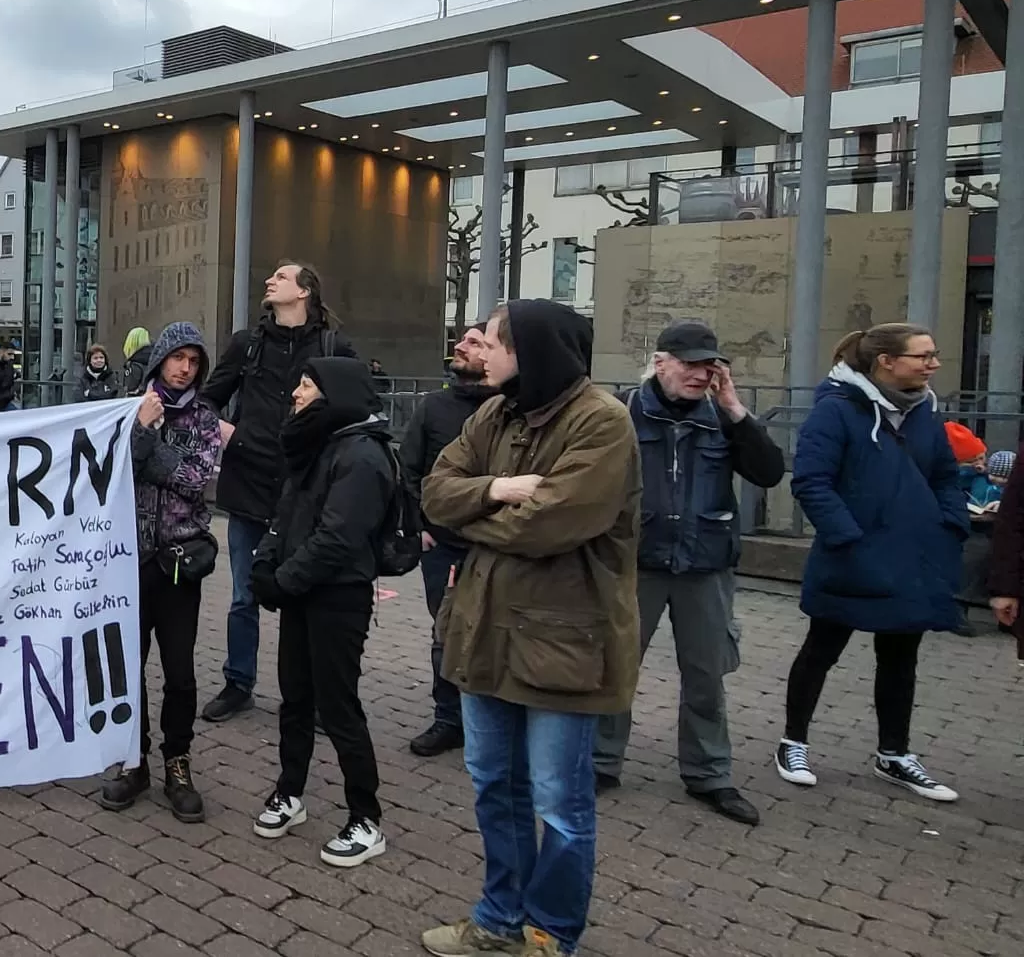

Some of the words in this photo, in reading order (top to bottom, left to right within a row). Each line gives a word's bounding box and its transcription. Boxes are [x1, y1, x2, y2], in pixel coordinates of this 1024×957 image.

[14, 530, 65, 549] Kaloyan
[11, 556, 46, 574] Fatih
[54, 575, 98, 592] Gürbüz
[14, 603, 62, 620] Gökhan
